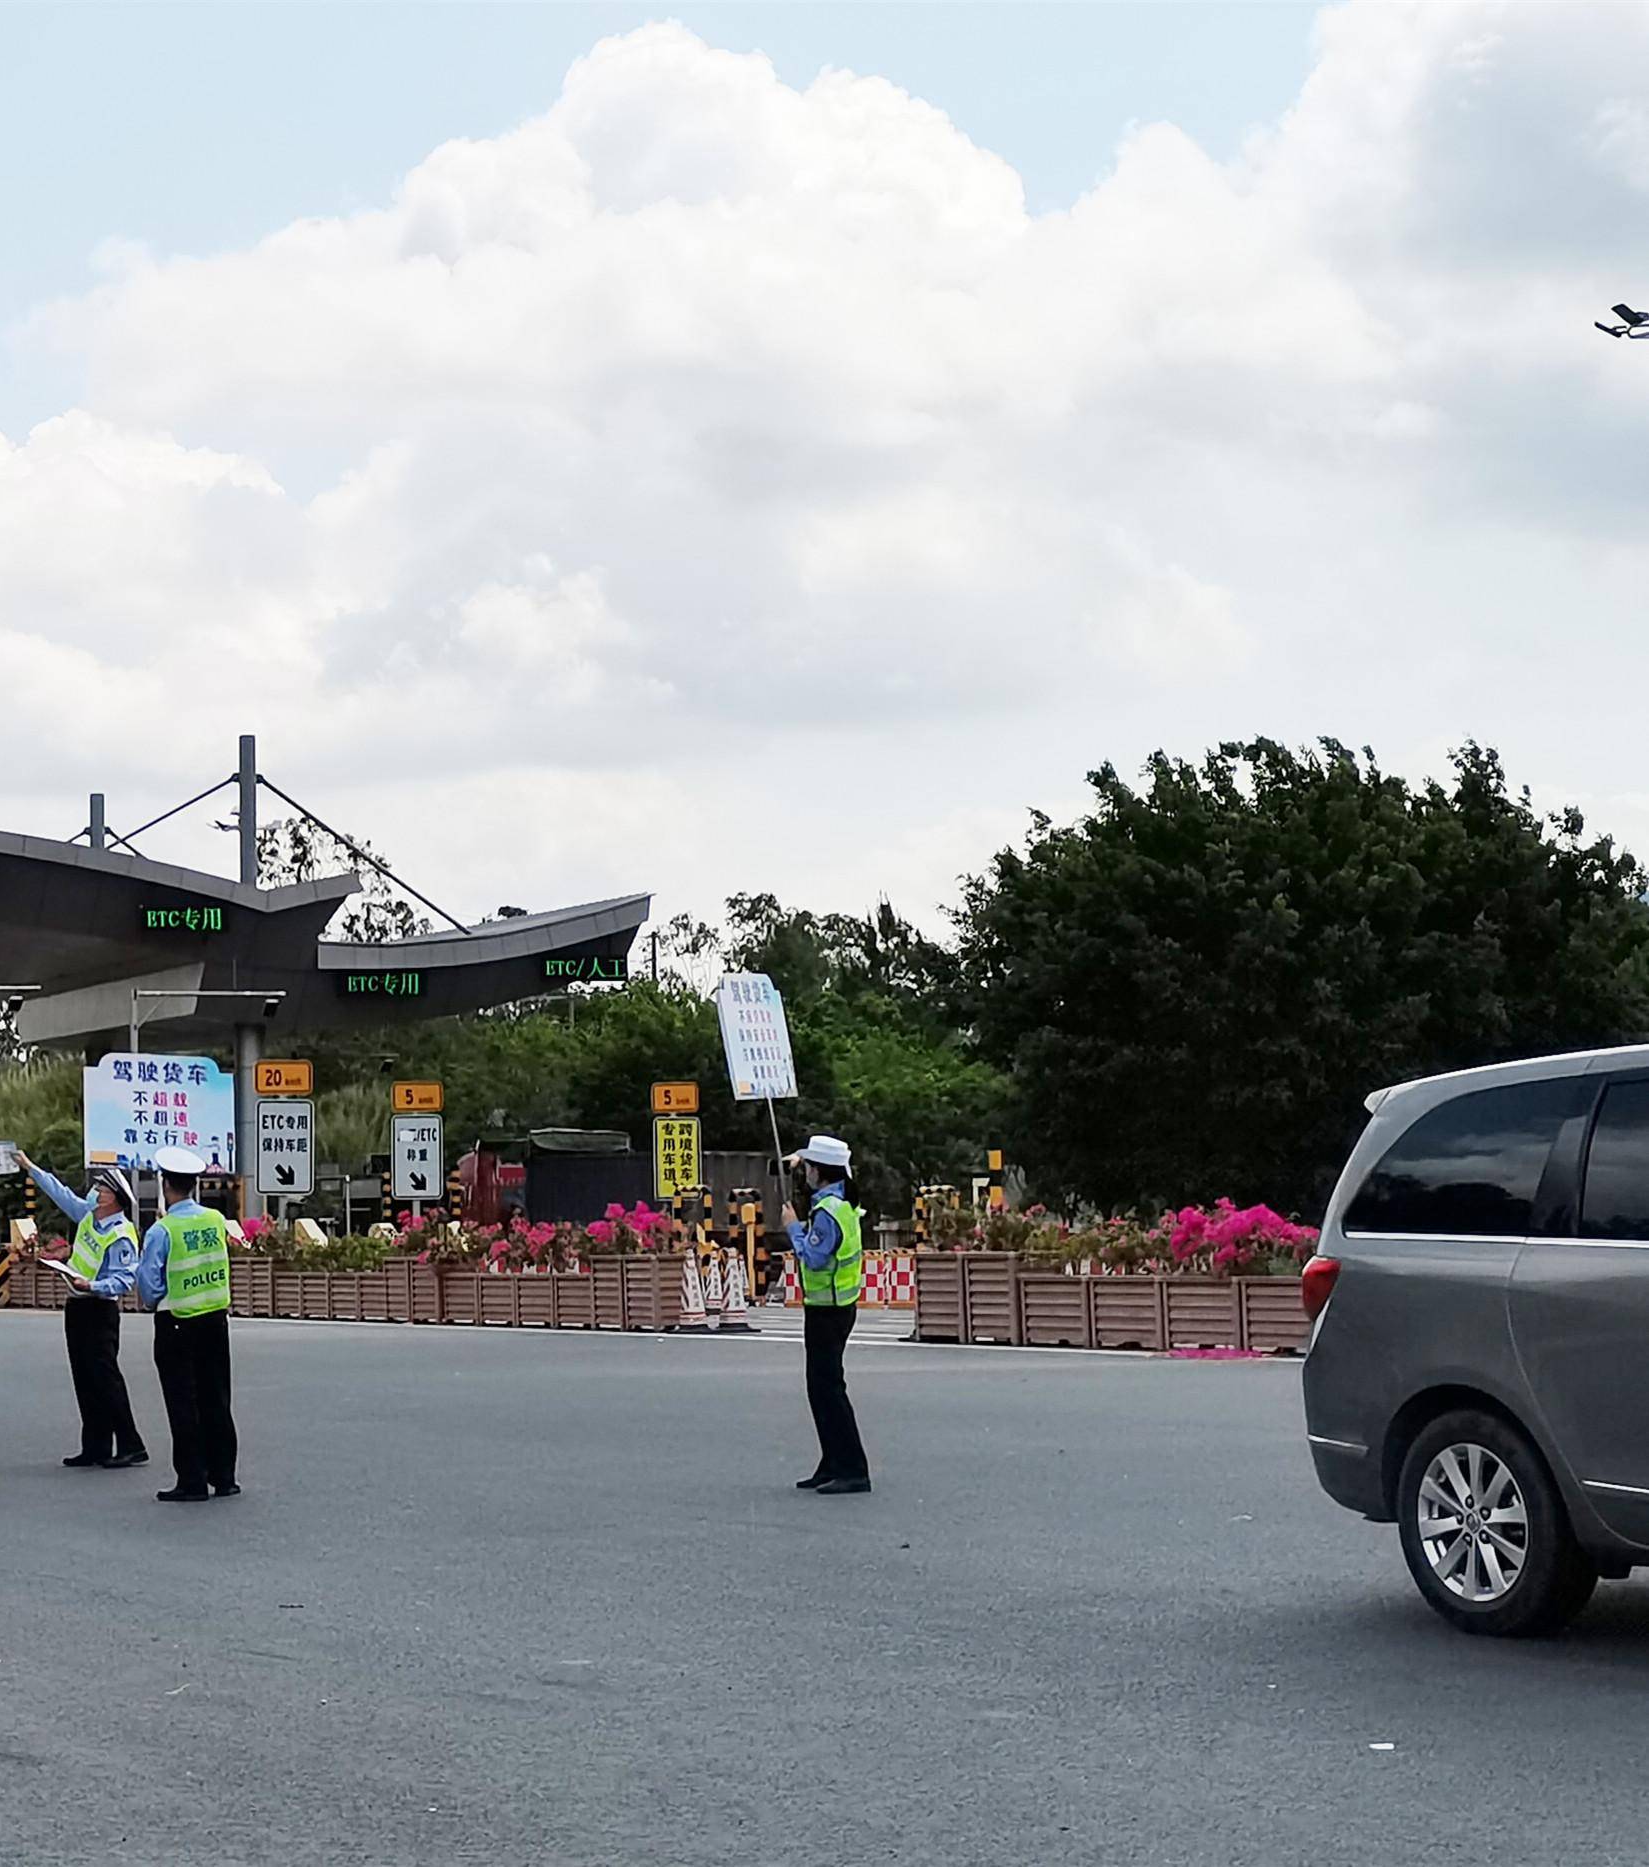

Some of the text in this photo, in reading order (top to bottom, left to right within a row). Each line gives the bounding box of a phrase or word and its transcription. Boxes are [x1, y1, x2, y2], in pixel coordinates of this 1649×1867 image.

[147, 907, 222, 930] ETC专用
[545, 958, 626, 978] ETC/人工
[348, 973, 420, 994] ETC专用
[113, 1059, 207, 1086] 驾驶货车
[265, 1069, 282, 1086] 20
[405, 1089, 414, 1105] 5
[663, 1089, 672, 1106] 5
[133, 1109, 188, 1127] 不超速
[262, 1114, 308, 1130] ETC专用
[123, 1128, 198, 1146] 靠右行驶
[262, 1137, 308, 1153] 保持车距
[182, 1226, 220, 1252] 警察
[183, 1268, 226, 1291] POLICE
